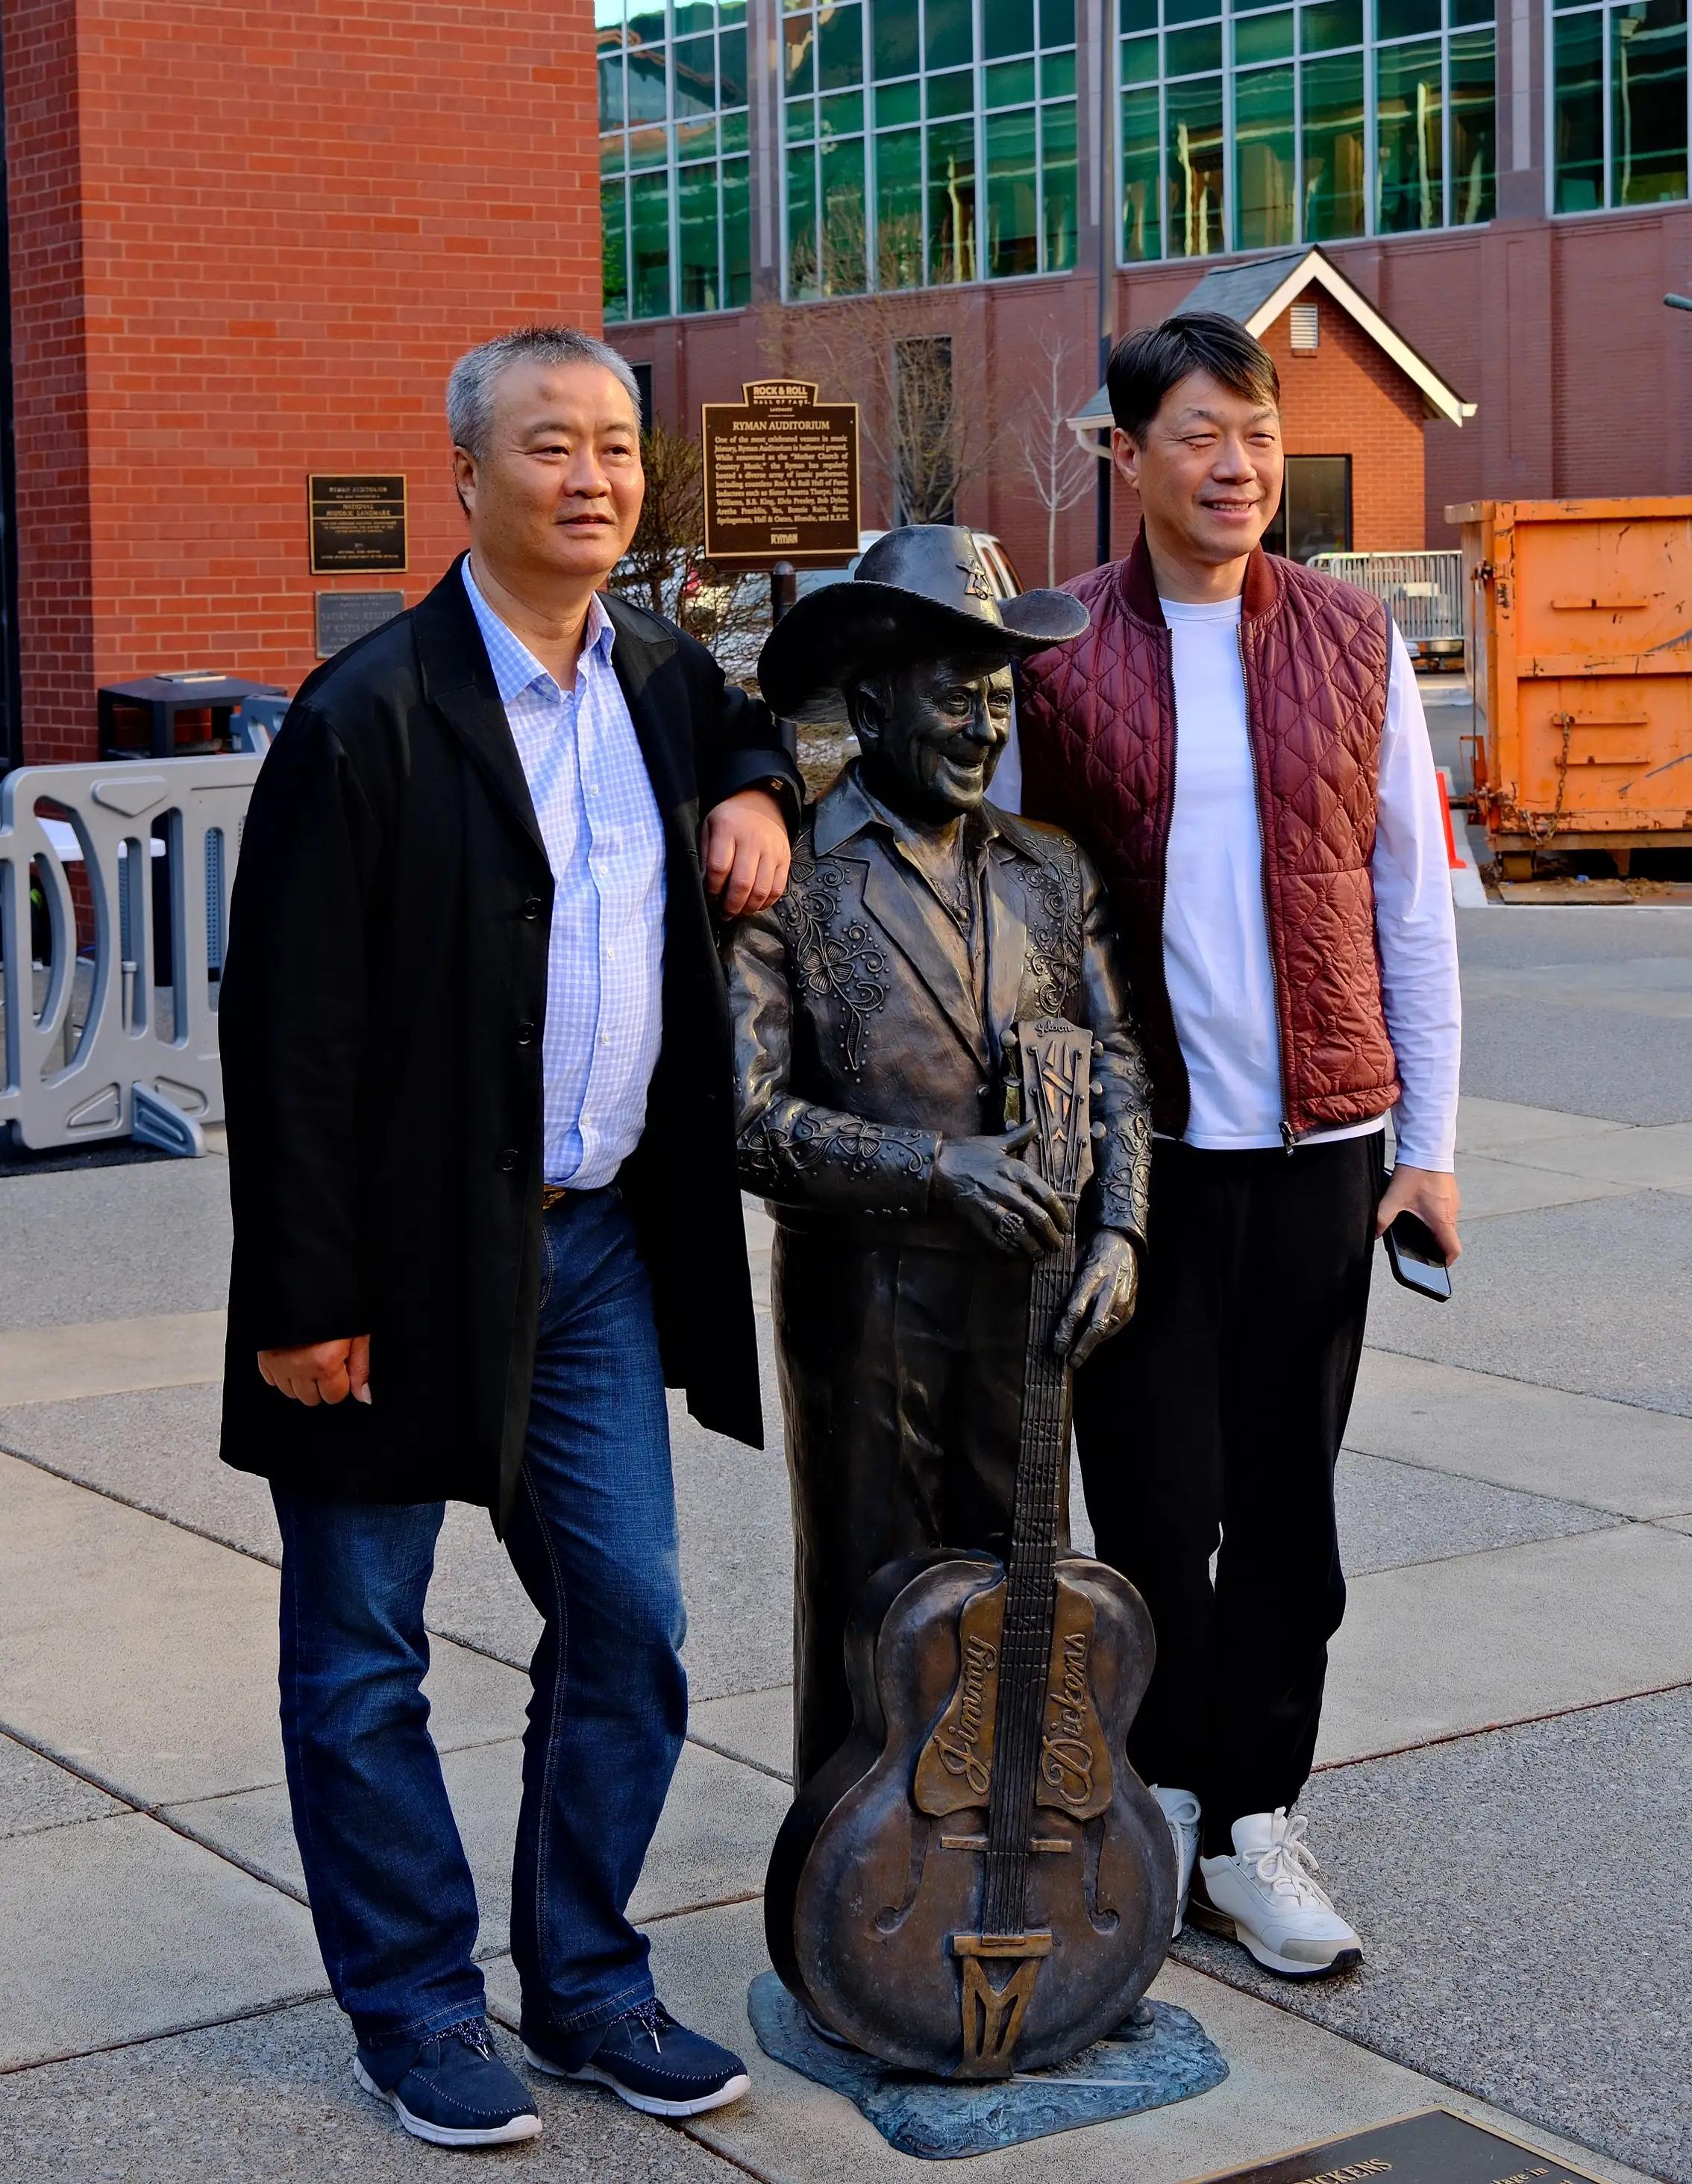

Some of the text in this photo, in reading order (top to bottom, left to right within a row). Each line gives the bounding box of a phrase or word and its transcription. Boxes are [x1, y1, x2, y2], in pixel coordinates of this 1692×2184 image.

[753, 386, 807, 395] ROCK & ROLL
[733, 421, 830, 430] RYMAN AUDITORIUM
[815, 471, 848, 479] performers,
[717, 517, 753, 526] Springsteen,
[771, 534, 798, 545] RYMAN
[933, 1635, 997, 1795] Jimmy
[1041, 1633, 1094, 1805] Dickens
[1292, 2159, 1392, 2184] ICKENS
[1524, 2168, 1550, 2176] in
